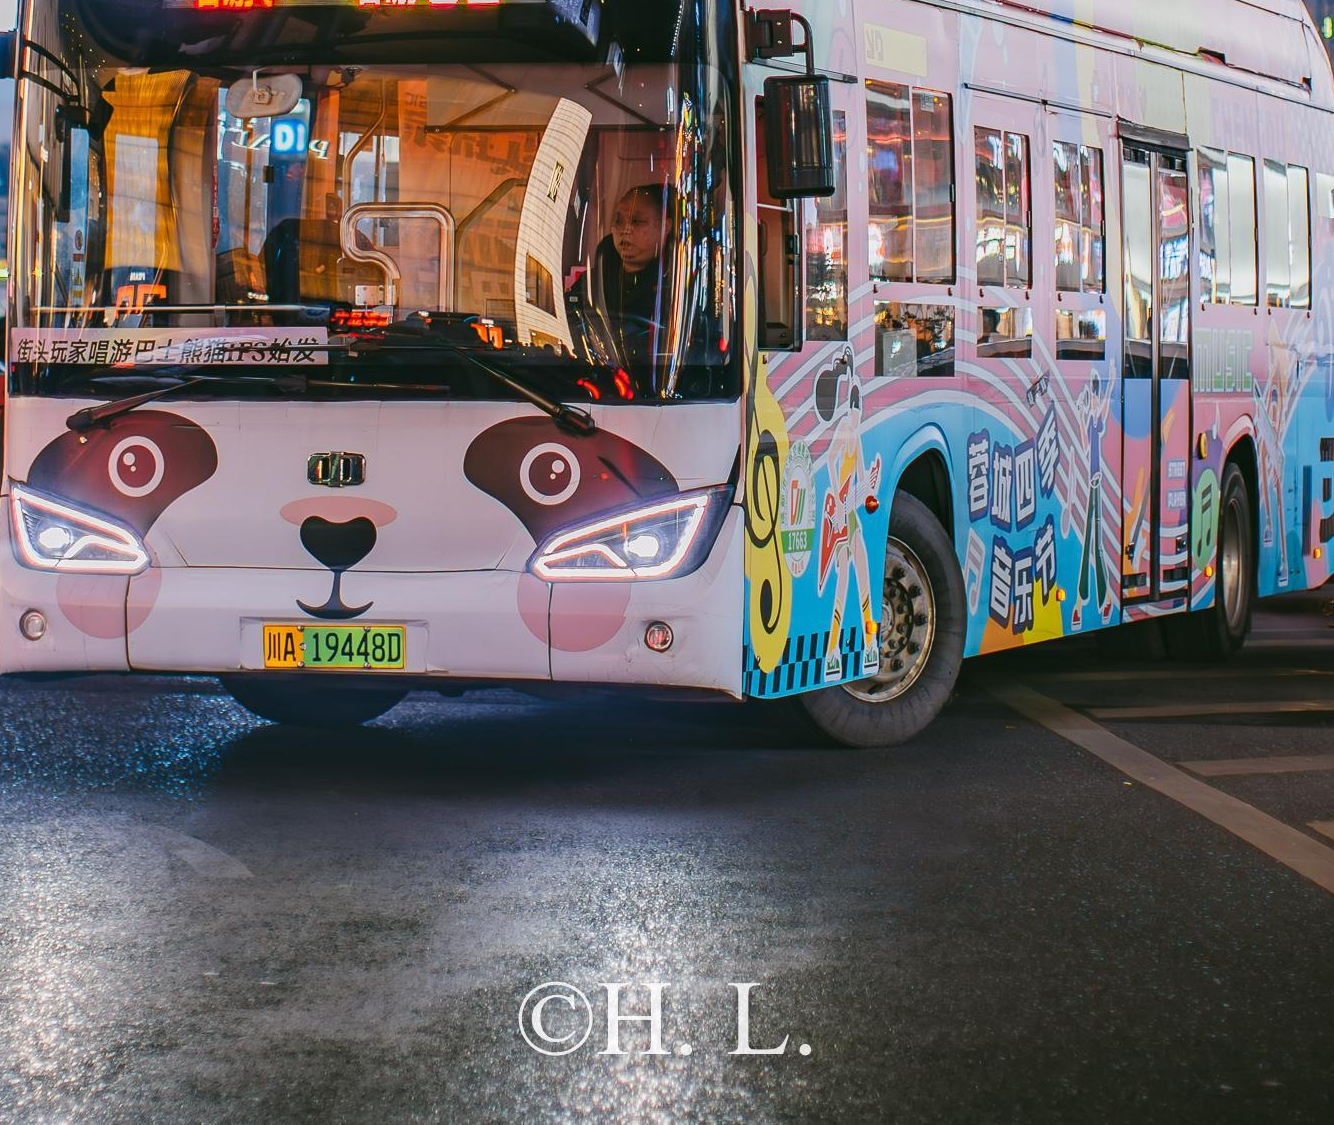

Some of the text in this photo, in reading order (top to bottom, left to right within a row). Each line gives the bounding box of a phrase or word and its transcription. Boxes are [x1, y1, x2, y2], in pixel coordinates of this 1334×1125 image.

[967, 404, 1060, 529] 蓉城四季
[787, 530, 808, 551] 17663
[990, 518, 1057, 629] 音乐节
[267, 632, 401, 663] 川A 19448D
